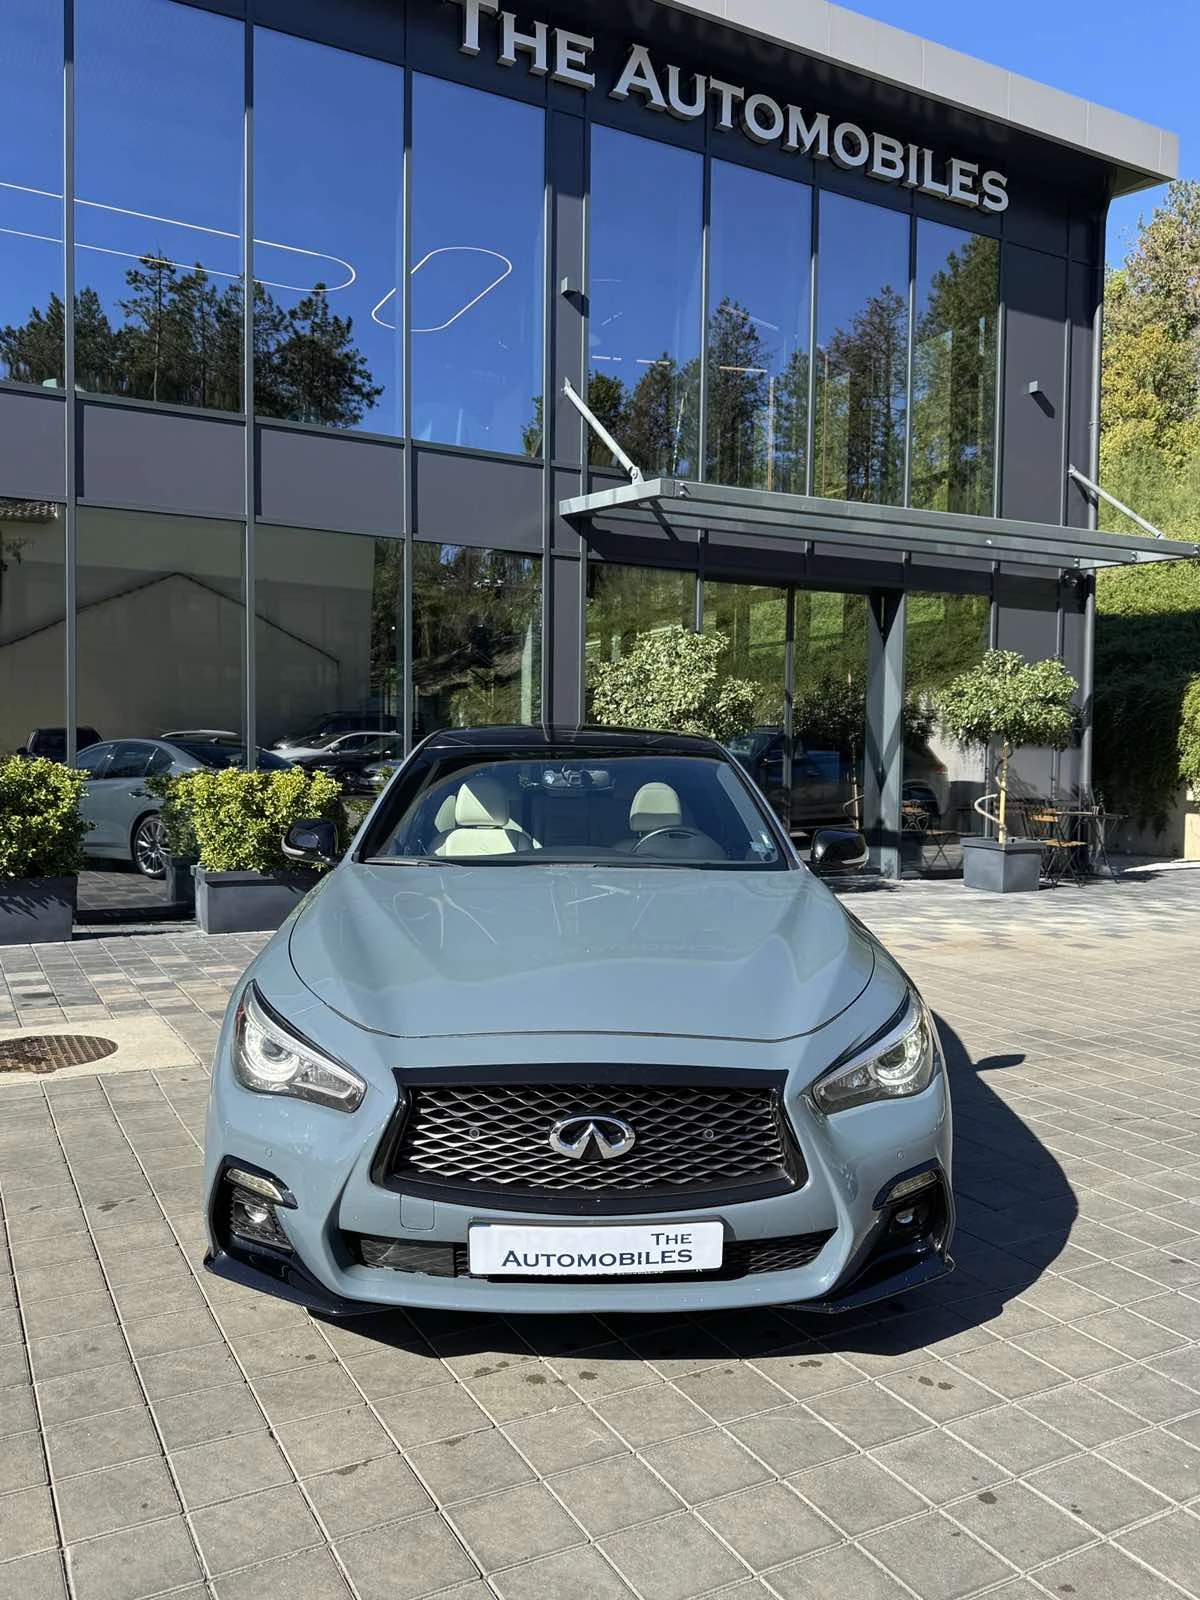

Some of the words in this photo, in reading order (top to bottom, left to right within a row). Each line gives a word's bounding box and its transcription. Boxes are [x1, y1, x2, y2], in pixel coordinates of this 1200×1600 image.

[446, 0, 595, 90] THE
[609, 43, 1010, 213] AUTOMOBILES
[650, 1232, 692, 1246] THE
[501, 1249, 693, 1268] AUTOMOBILES
